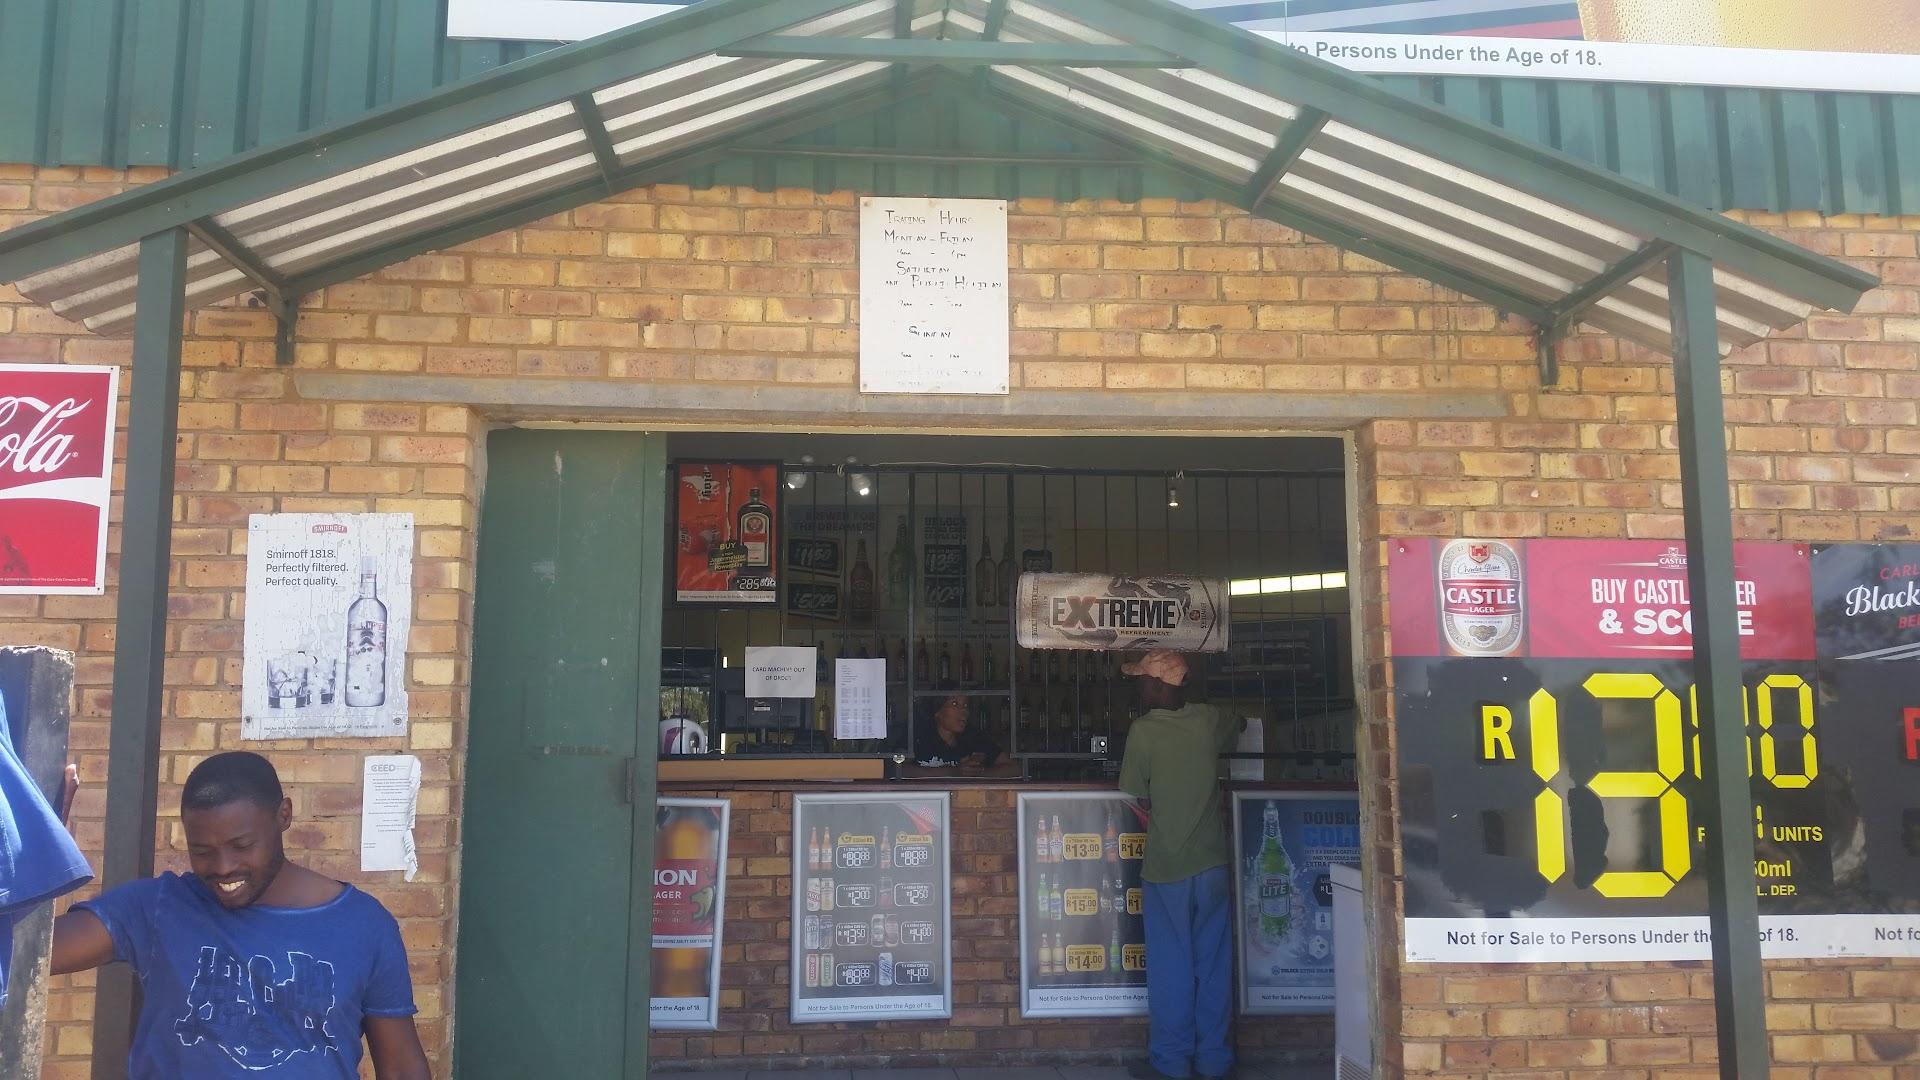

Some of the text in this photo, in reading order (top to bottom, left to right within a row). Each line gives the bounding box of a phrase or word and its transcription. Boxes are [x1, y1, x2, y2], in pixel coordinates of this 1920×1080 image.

[1316, 42, 1397, 59] Persons
[1404, 44, 1463, 61] Under
[1470, 46, 1500, 62] the
[1506, 47, 1543, 66] Age
[1550, 49, 1569, 64] of
[1575, 50, 1602, 66] 18.
[313, 524, 346, 533] SMIRNOFF
[719, 542, 736, 550] BUY
[266, 549, 337, 559] Smirnoff 1818.
[266, 562, 349, 573] Perfectly filtered.
[1880, 564, 1919, 579] CARL
[265, 575, 338, 587] Perfect quality.
[1446, 587, 1516, 604] CASTLE
[1591, 578, 1627, 604] BUY
[1634, 579, 1690, 604] CASTL
[1845, 580, 1920, 616] Black
[1053, 596, 1176, 629] EXTREME
[1599, 608, 1624, 634] &
[1482, 704, 1516, 759] R
[1772, 826, 1823, 842] UNITS
[654, 869, 698, 886] ION
[652, 890, 682, 899] AGER
[1263, 885, 1287, 897] LITE
[1771, 885, 1798, 896] DEP.
[1447, 931, 1476, 945] Not
[1480, 931, 1504, 945] for
[1510, 931, 1545, 945] Sale
[1550, 932, 1566, 944] to
[1571, 930, 1637, 944] Persons
[1642, 930, 1688, 944] Under
[1759, 928, 1772, 941] of
[1777, 928, 1799, 941] 18.
[1875, 927, 1920, 941] Not fo
[674, 1004, 686, 1013] Age
